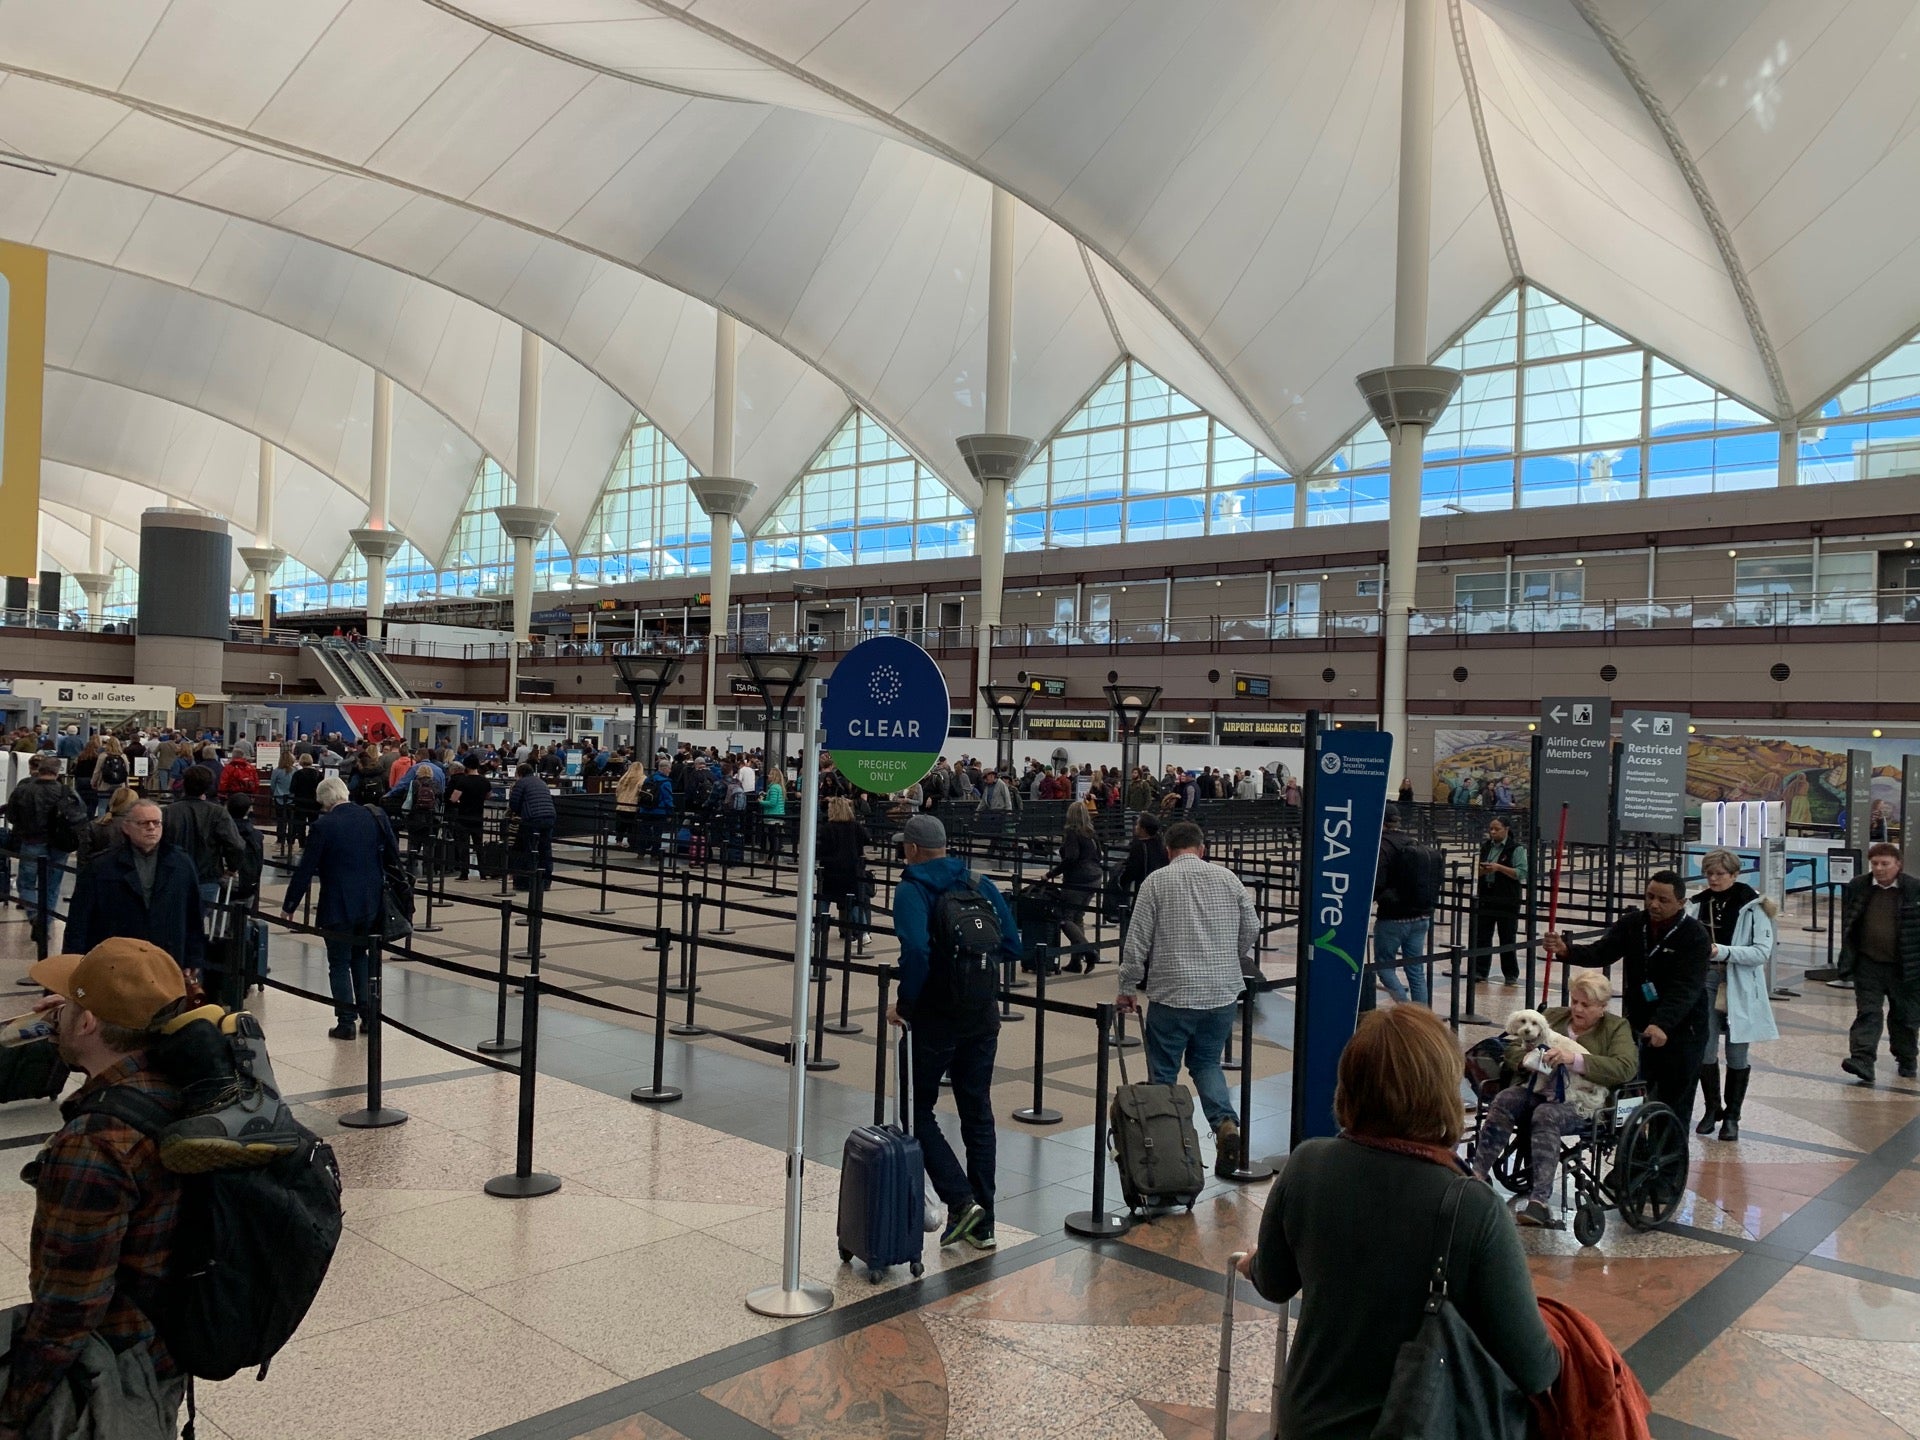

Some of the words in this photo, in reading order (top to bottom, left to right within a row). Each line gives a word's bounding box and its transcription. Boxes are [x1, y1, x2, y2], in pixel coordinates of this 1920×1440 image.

[736, 683, 747, 692] TSA
[77, 692, 89, 700] to
[92, 692, 104, 701] all
[107, 693, 135, 702] Gates
[848, 719, 920, 737] CLEAR
[1030, 719, 1054, 727] AIRPORT
[1055, 719, 1081, 728] BAGGAGE
[1082, 720, 1106, 728] CENTER
[1223, 722, 1254, 732] AIRPORT
[1255, 723, 1288, 733] BAGGAGE
[1546, 736, 1578, 747] Airline
[1580, 737, 1606, 747] Crew
[1546, 748, 1592, 759] Members
[1628, 743, 1682, 755] Restricted
[1342, 755, 1384, 763] Transportation
[1627, 755, 1662, 766] Access
[858, 760, 907, 770] PRECHECK
[1342, 762, 1367, 770] Security
[870, 772, 895, 781] ONLY
[1342, 768, 1385, 776] Administration
[1575, 769, 1589, 777] Only
[1650, 790, 1679, 798] Passengers
[1645, 812, 1673, 820] Employees
[1323, 799, 1352, 861] TSA
[1320, 871, 1349, 927] Pre
